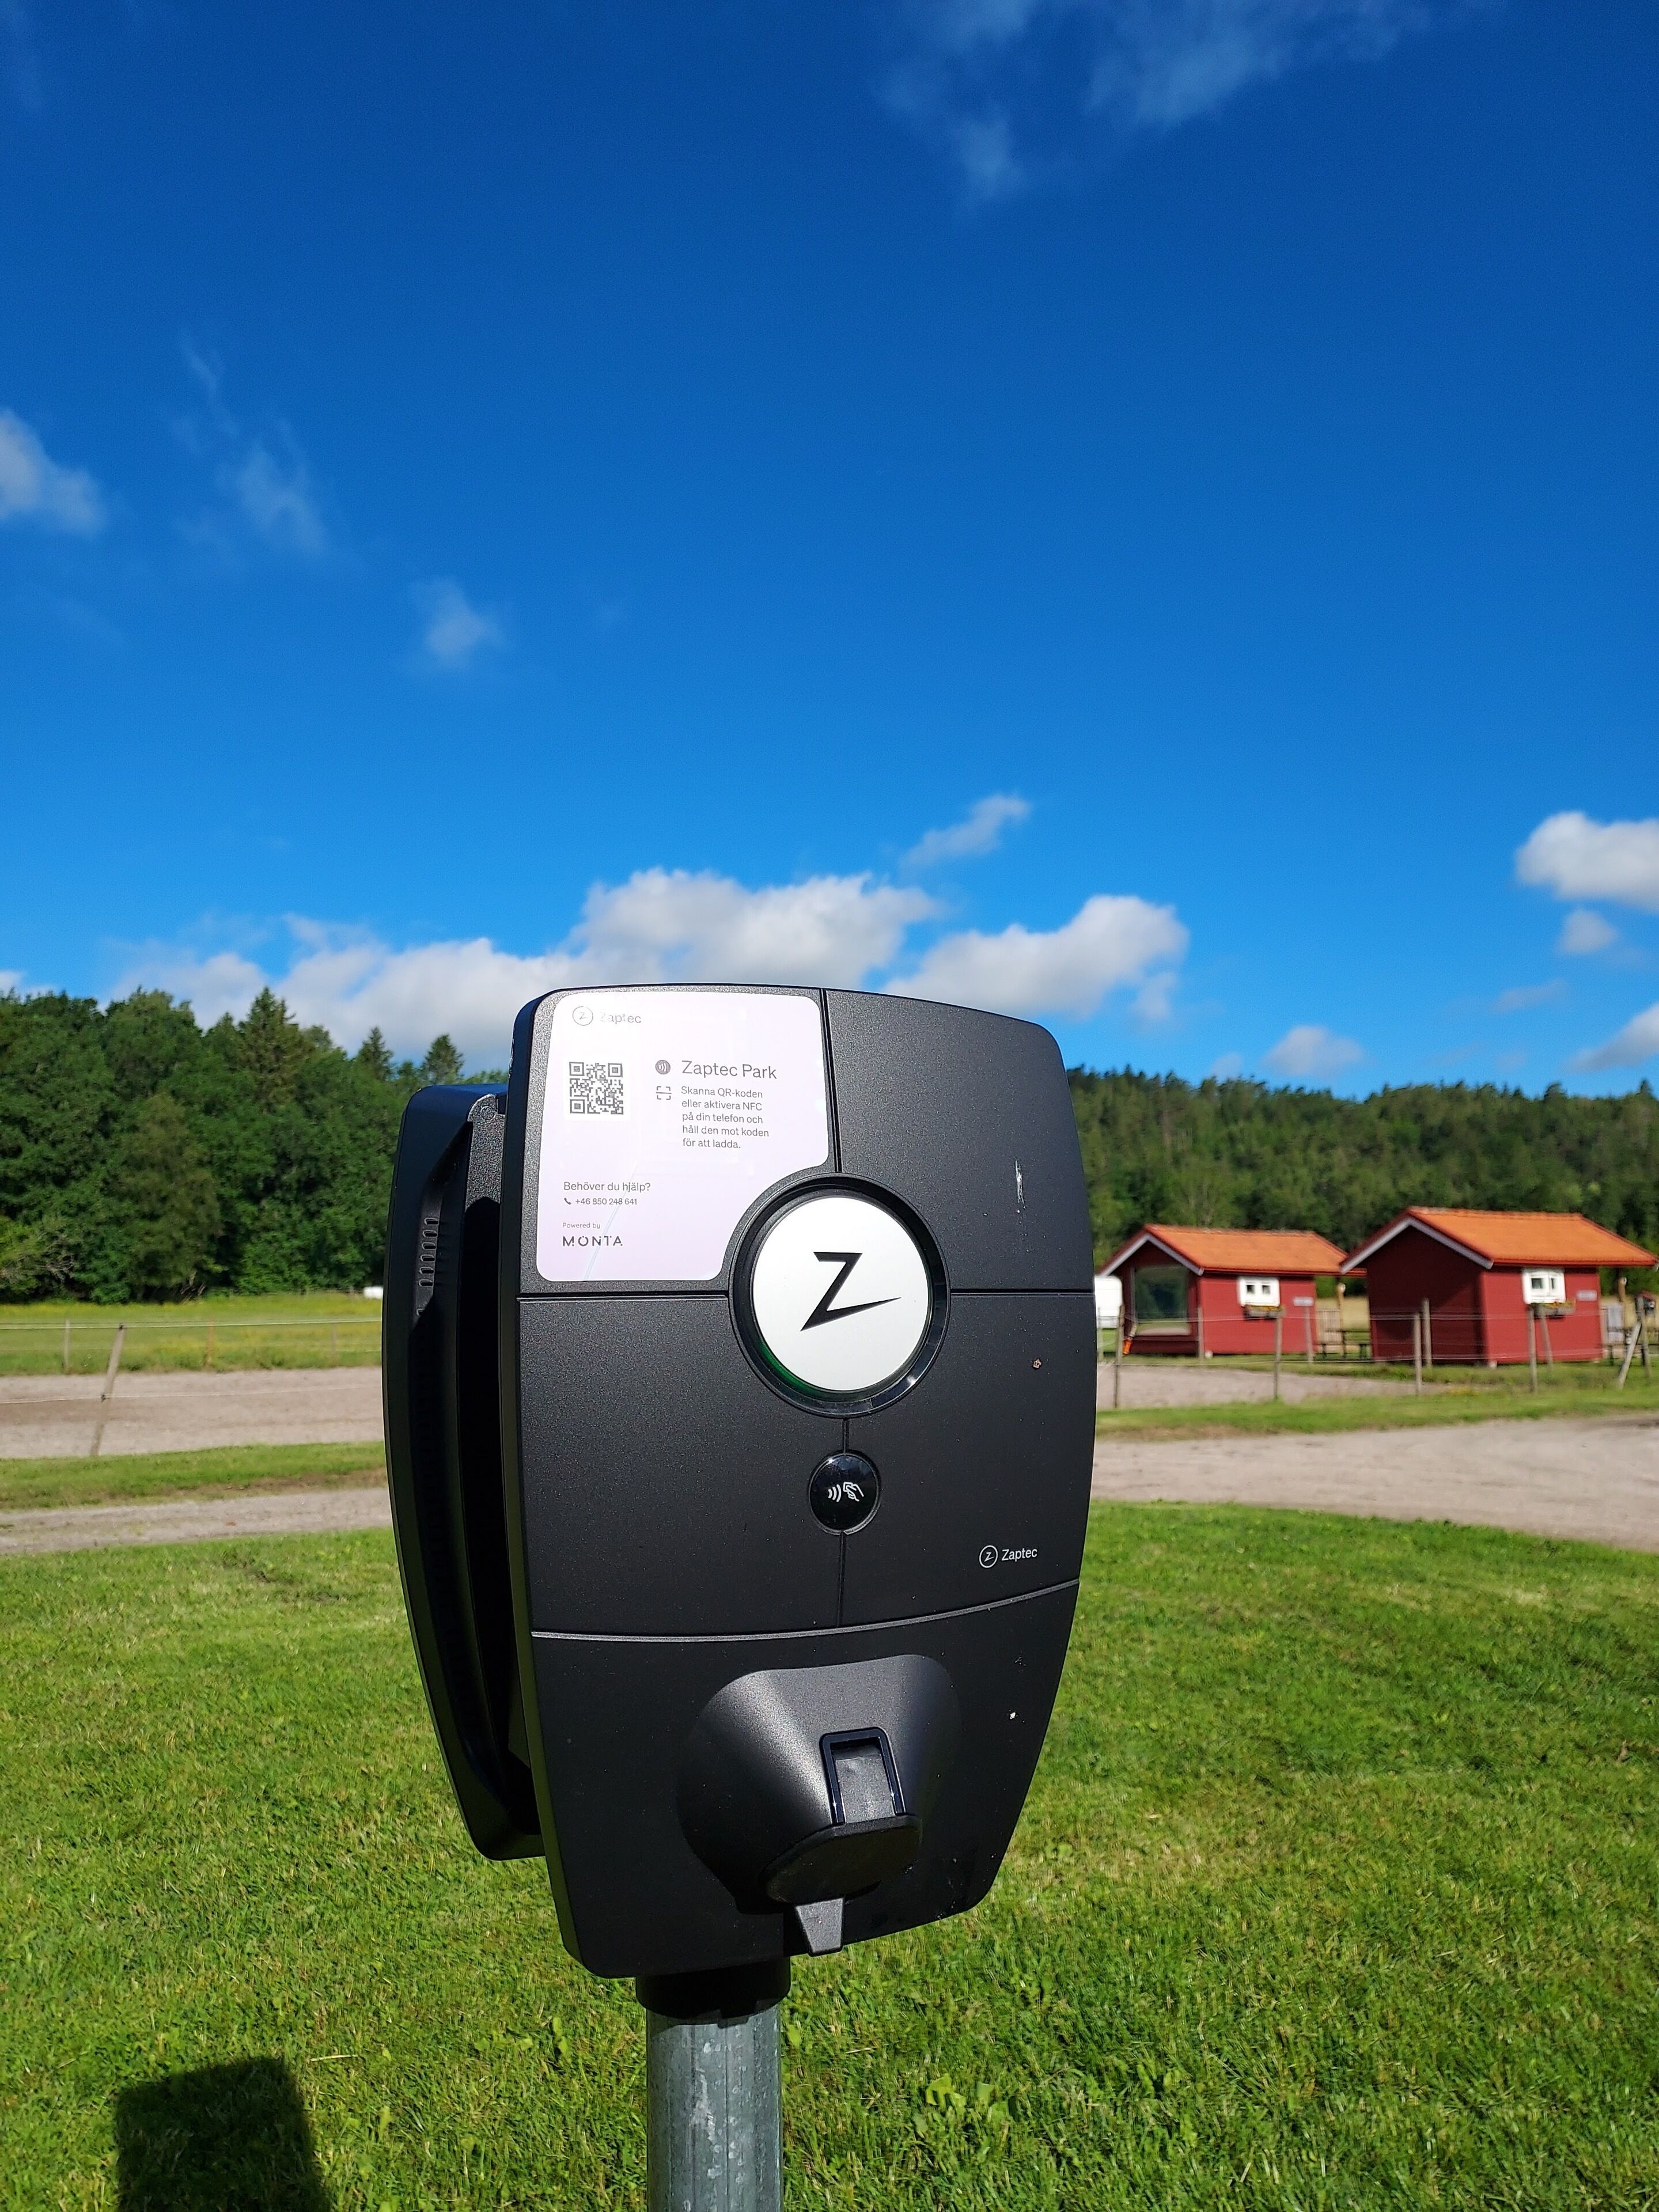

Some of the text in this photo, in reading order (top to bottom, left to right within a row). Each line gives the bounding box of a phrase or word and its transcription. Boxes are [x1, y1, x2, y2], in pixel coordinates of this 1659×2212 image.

[599, 1012, 641, 1024] Zaptec
[682, 1060, 777, 1079] Zaptec Park
[681, 1086, 763, 1098] Skanna QR-koden
[682, 1100, 762, 1111] eller aktivera NFC
[682, 1112, 694, 1122] på
[696, 1113, 710, 1121] din
[713, 1113, 744, 1122] telefon
[683, 1125, 769, 1137] håll den mot koden
[683, 1138, 695, 1147] för
[713, 1139, 741, 1148] ladda.
[564, 1181, 605, 1191] Behöver
[623, 1183, 650, 1193] hjälp?
[1002, 1548, 1037, 1562] Zaptec
